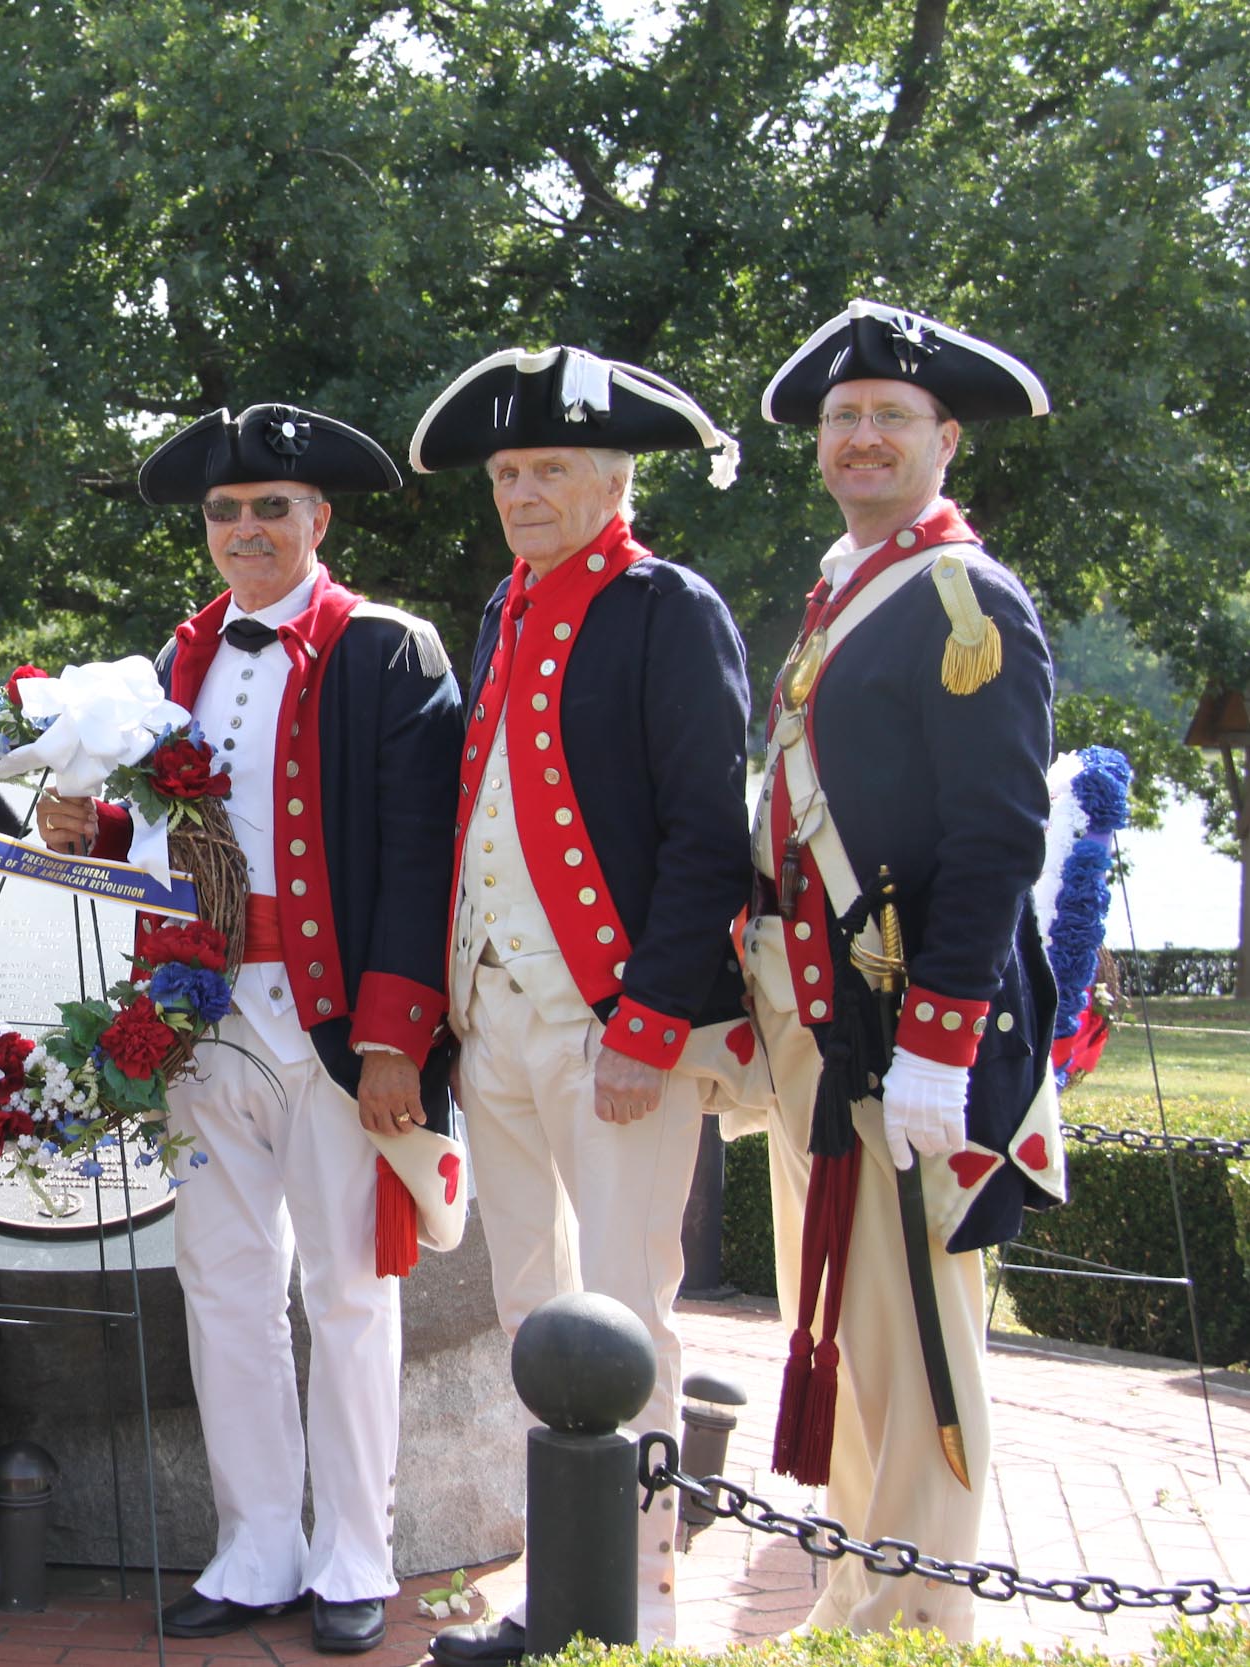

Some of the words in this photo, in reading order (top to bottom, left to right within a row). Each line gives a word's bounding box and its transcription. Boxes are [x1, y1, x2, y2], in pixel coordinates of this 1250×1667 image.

[5, 858, 18, 868] OF
[20, 863, 37, 874] THE
[39, 868, 87, 887] AMERICAN
[88, 878, 145, 899] REVOLUTION
[21, 852, 70, 872] PRESIDENT
[72, 865, 110, 880] GENERAL
